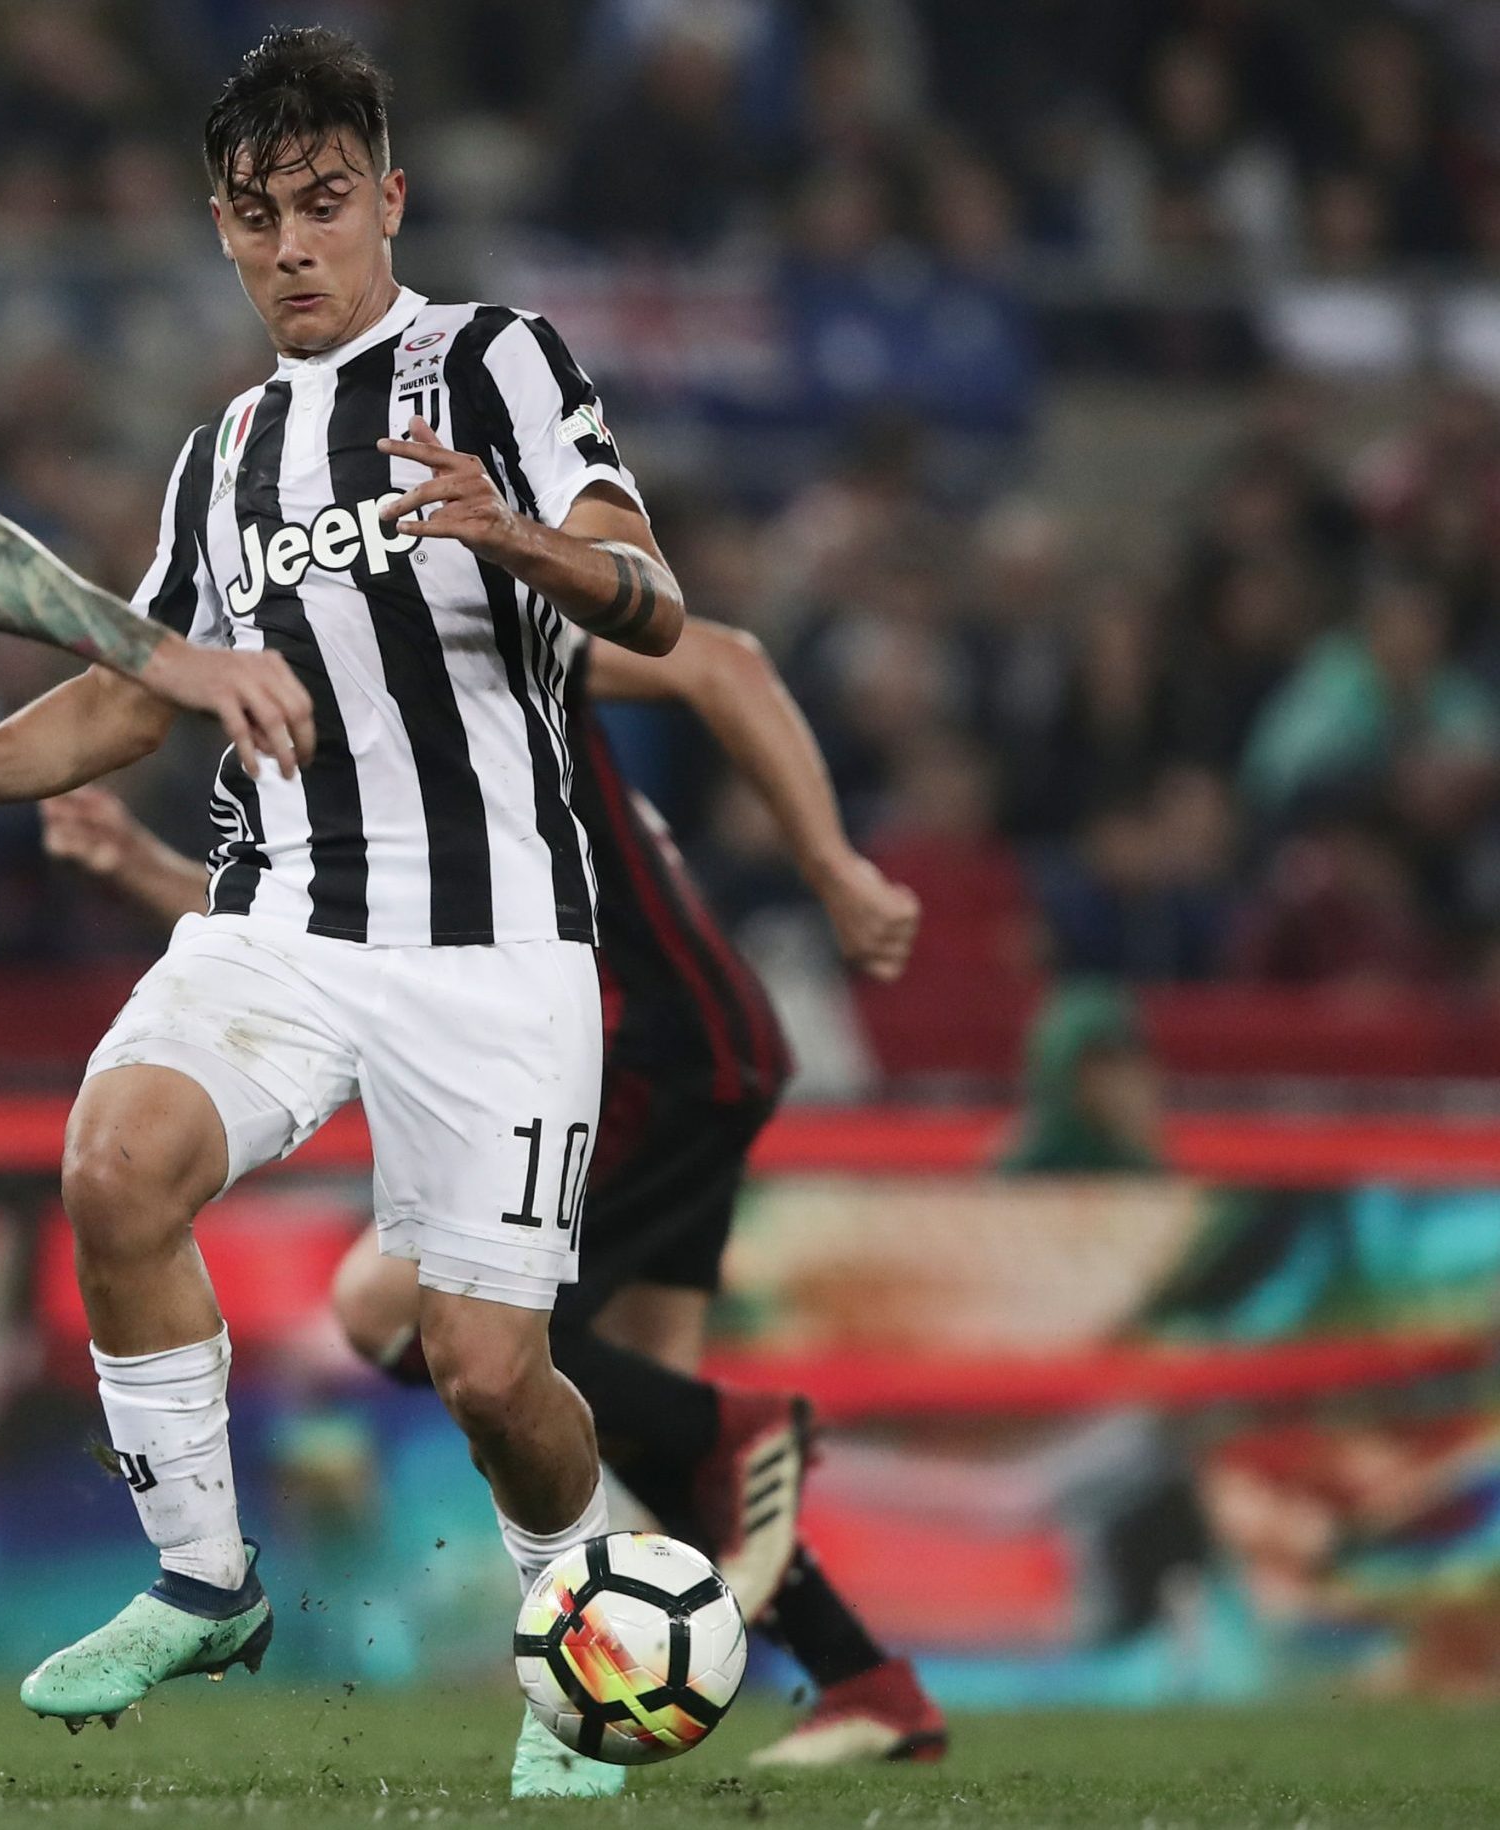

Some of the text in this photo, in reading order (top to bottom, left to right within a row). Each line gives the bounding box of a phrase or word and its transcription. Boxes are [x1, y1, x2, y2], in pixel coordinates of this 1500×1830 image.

[398, 372, 439, 392] JUVENTUS
[227, 491, 420, 615] Jeep
[501, 1117, 589, 1230] 10
